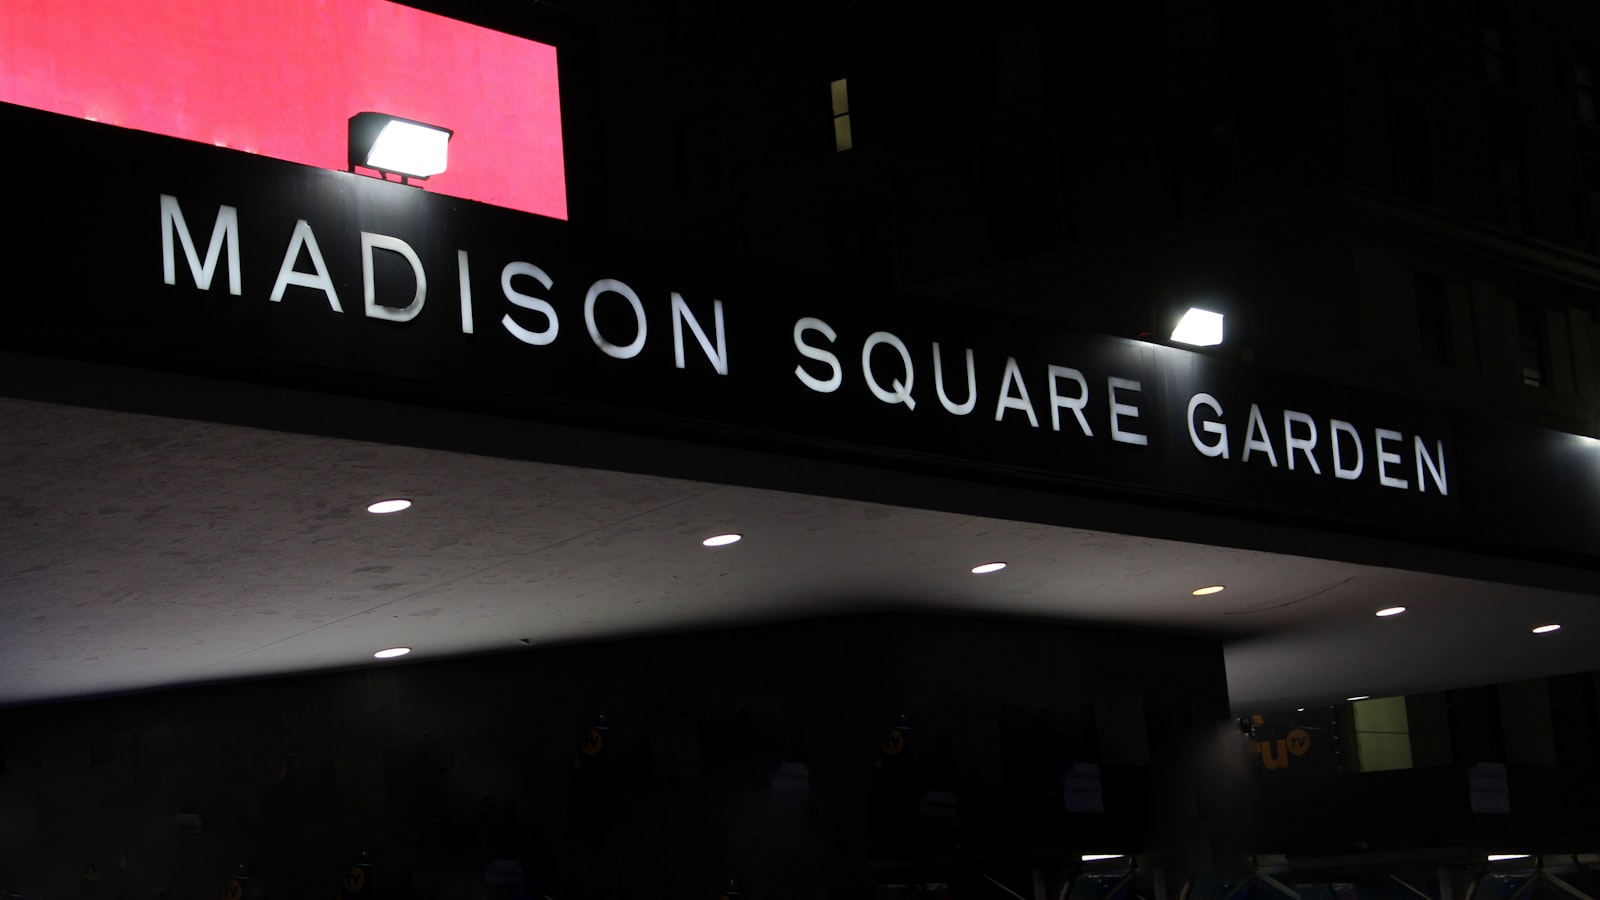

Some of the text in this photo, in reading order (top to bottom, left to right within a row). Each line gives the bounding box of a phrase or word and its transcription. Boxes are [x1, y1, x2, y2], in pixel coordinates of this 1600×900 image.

[160, 194, 1448, 496] MADISON SQUARE GARDEN
